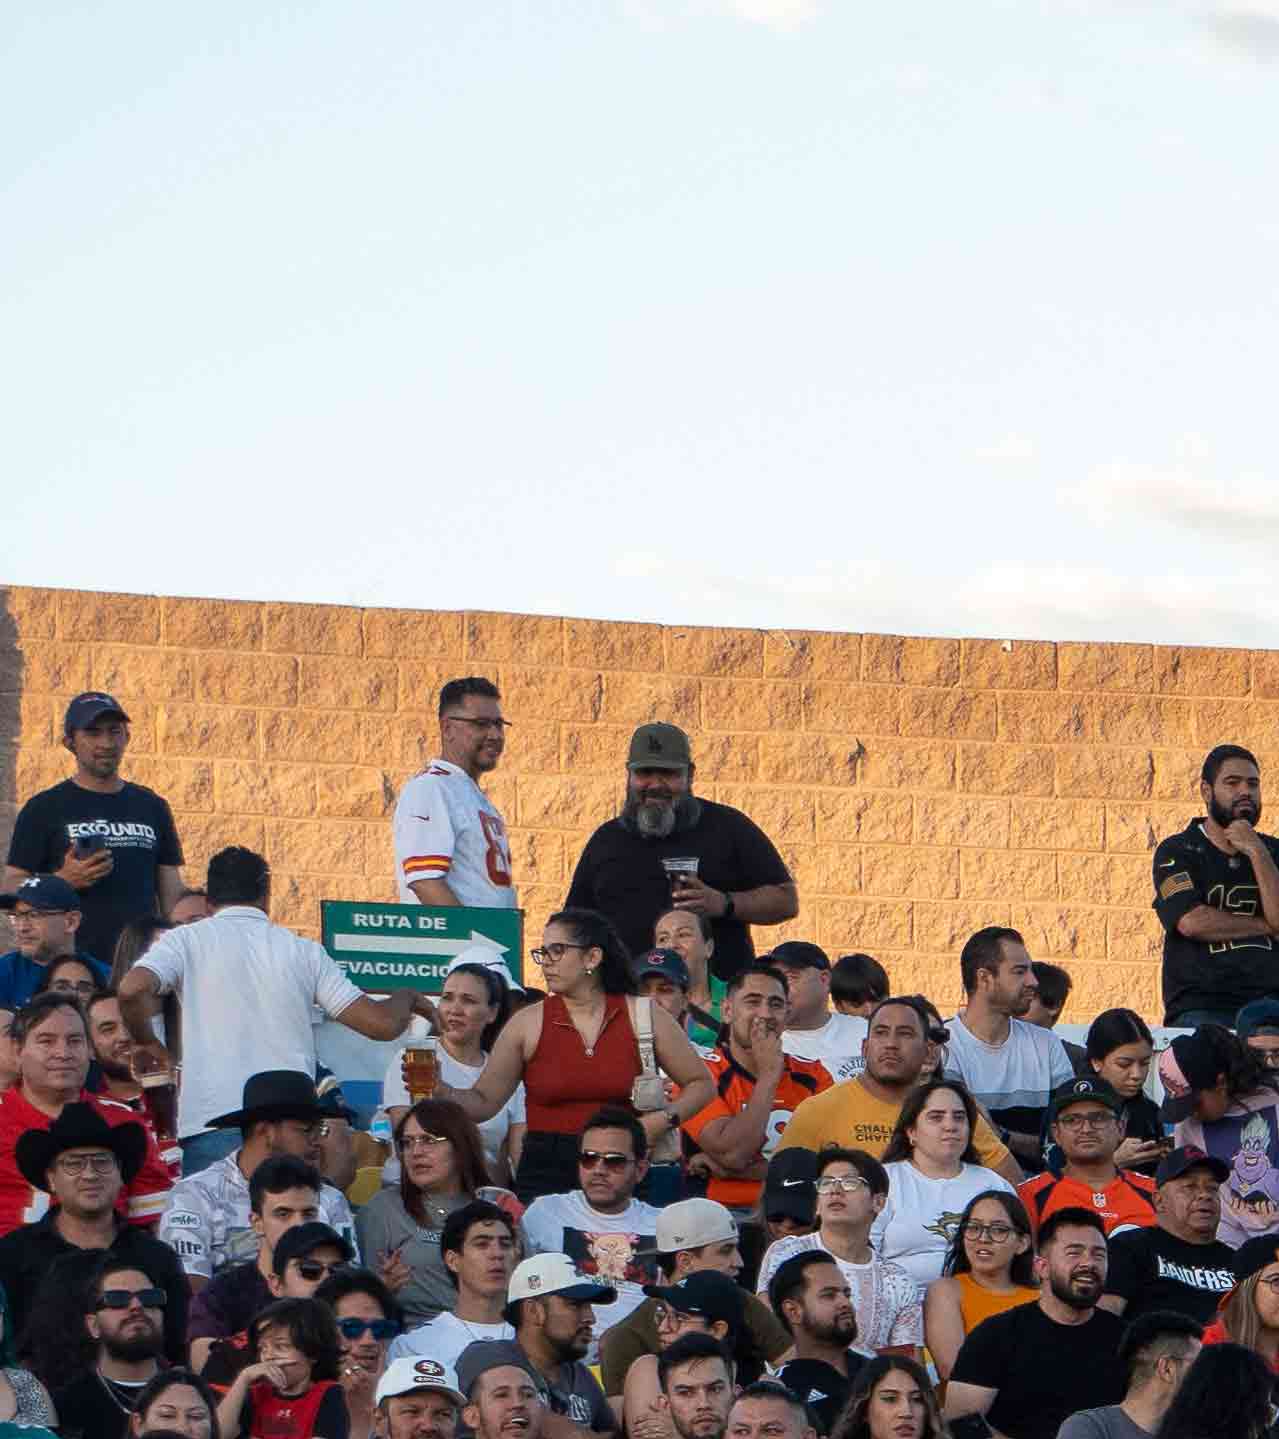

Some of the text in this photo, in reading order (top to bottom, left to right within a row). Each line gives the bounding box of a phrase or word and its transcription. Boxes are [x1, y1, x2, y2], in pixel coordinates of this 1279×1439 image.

[353, 913, 448, 931] RUTA DE
[335, 960, 451, 978] EVACUACIO
